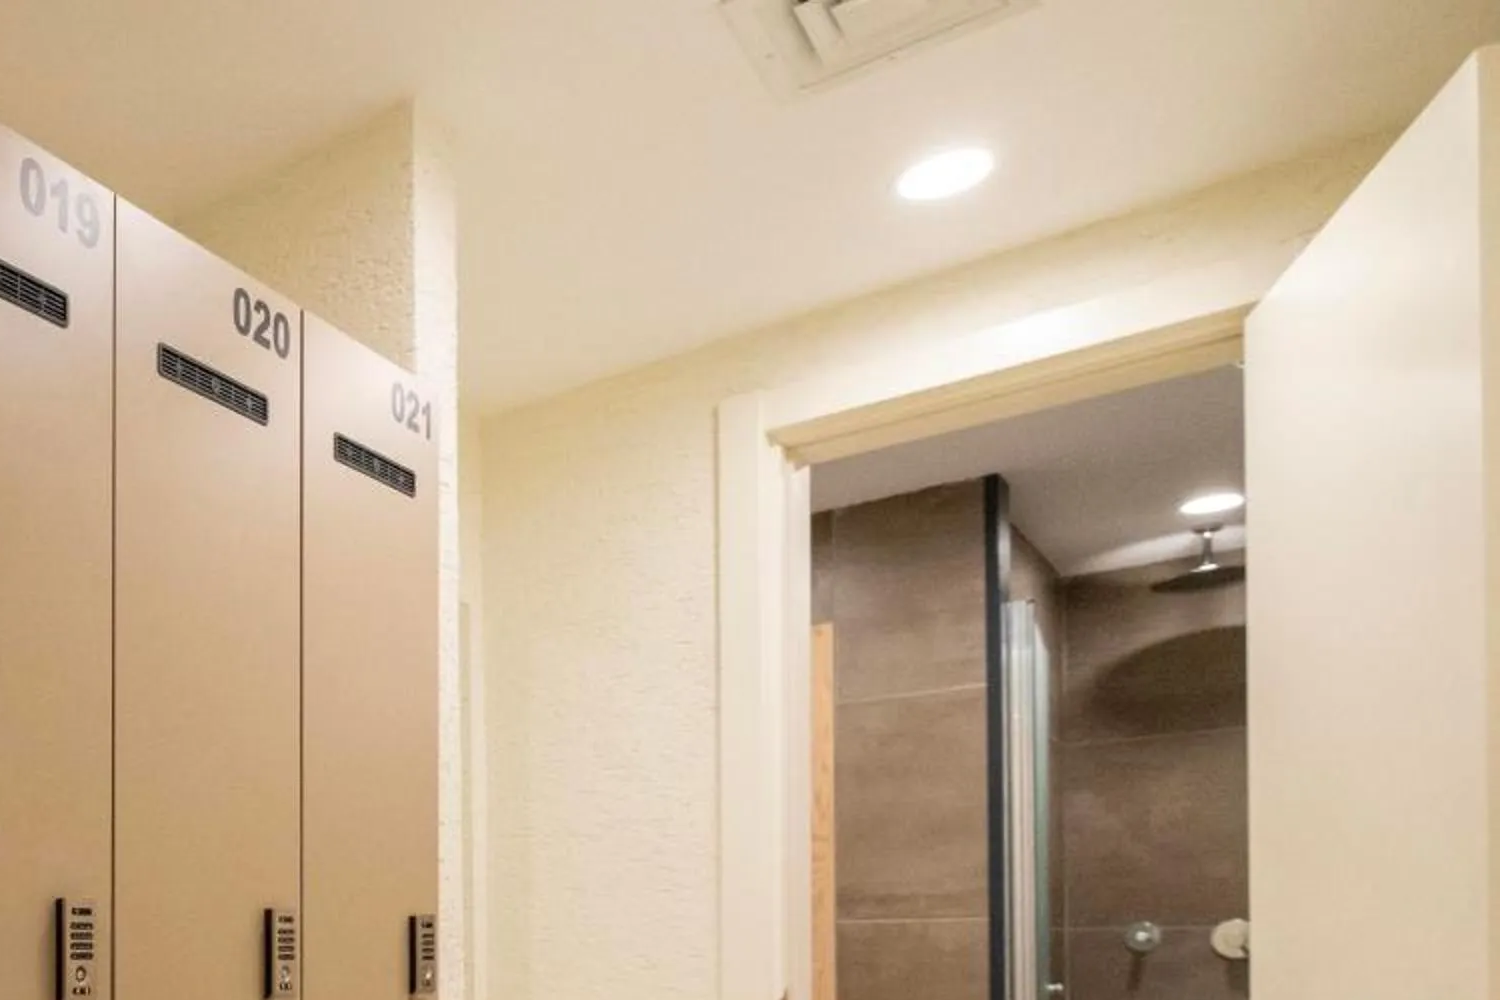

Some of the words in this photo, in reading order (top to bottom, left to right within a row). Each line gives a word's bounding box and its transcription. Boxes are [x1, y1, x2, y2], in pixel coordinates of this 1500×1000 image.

[20, 157, 100, 248] 019
[233, 287, 290, 359] 020
[392, 383, 431, 441] 021
